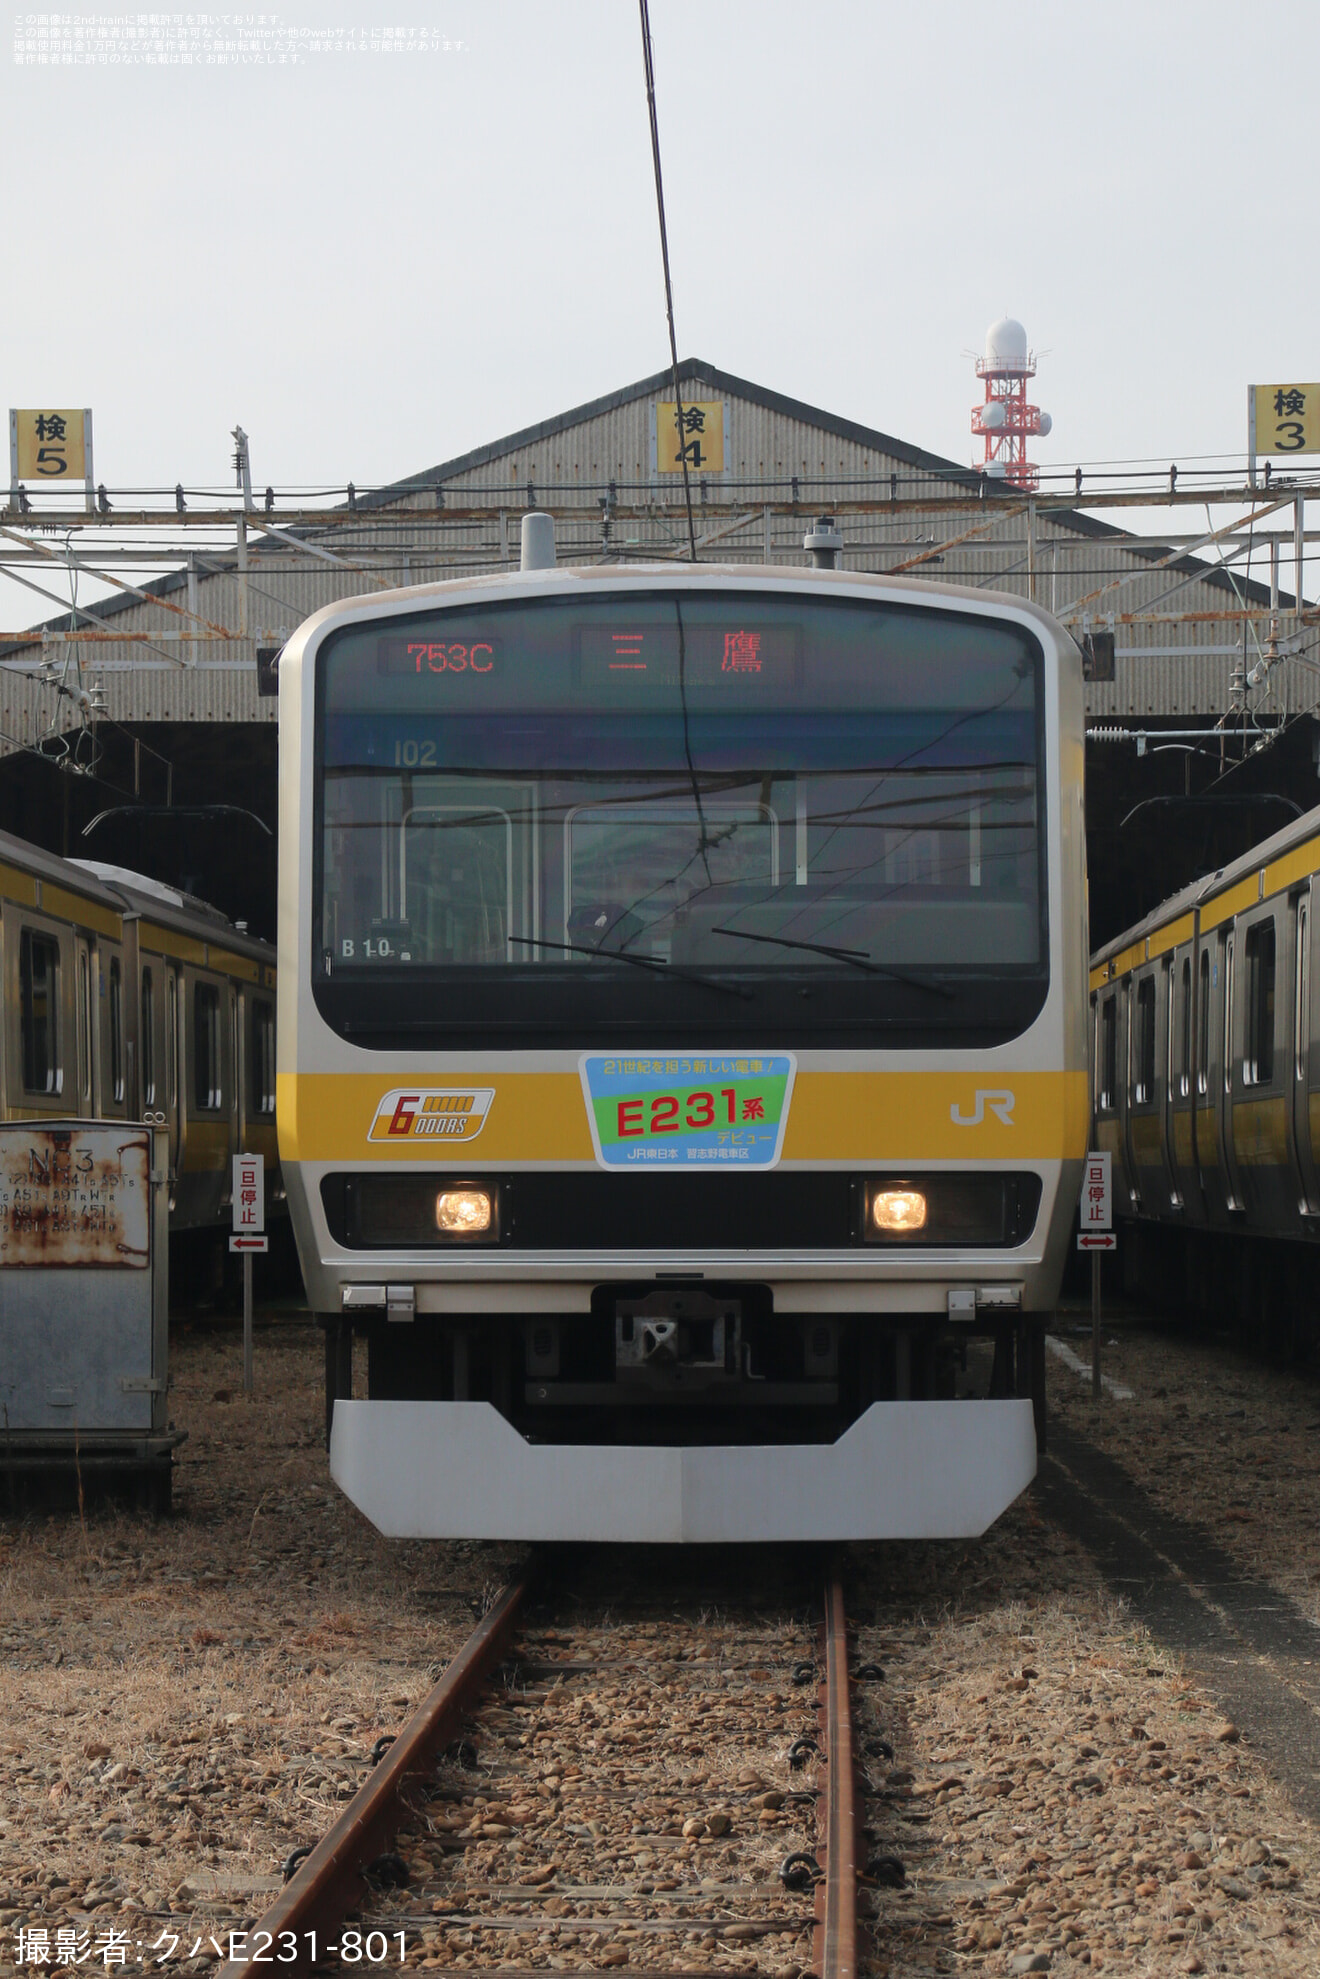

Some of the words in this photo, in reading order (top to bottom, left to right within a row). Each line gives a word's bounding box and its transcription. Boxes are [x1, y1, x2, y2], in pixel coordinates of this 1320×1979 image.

[407, 643, 493, 673] 753C
[394, 740, 437, 767] 102
[388, 1096, 420, 1134] 6
[617, 1088, 765, 1138] E231系
[950, 1089, 1015, 1126] JR
[627, 1148, 679, 1159] JR東日本
[717, 1130, 773, 1145] デビュー
[240, 1161, 257, 1225] 一旦停止
[1087, 1158, 1105, 1222] 一旦停止
